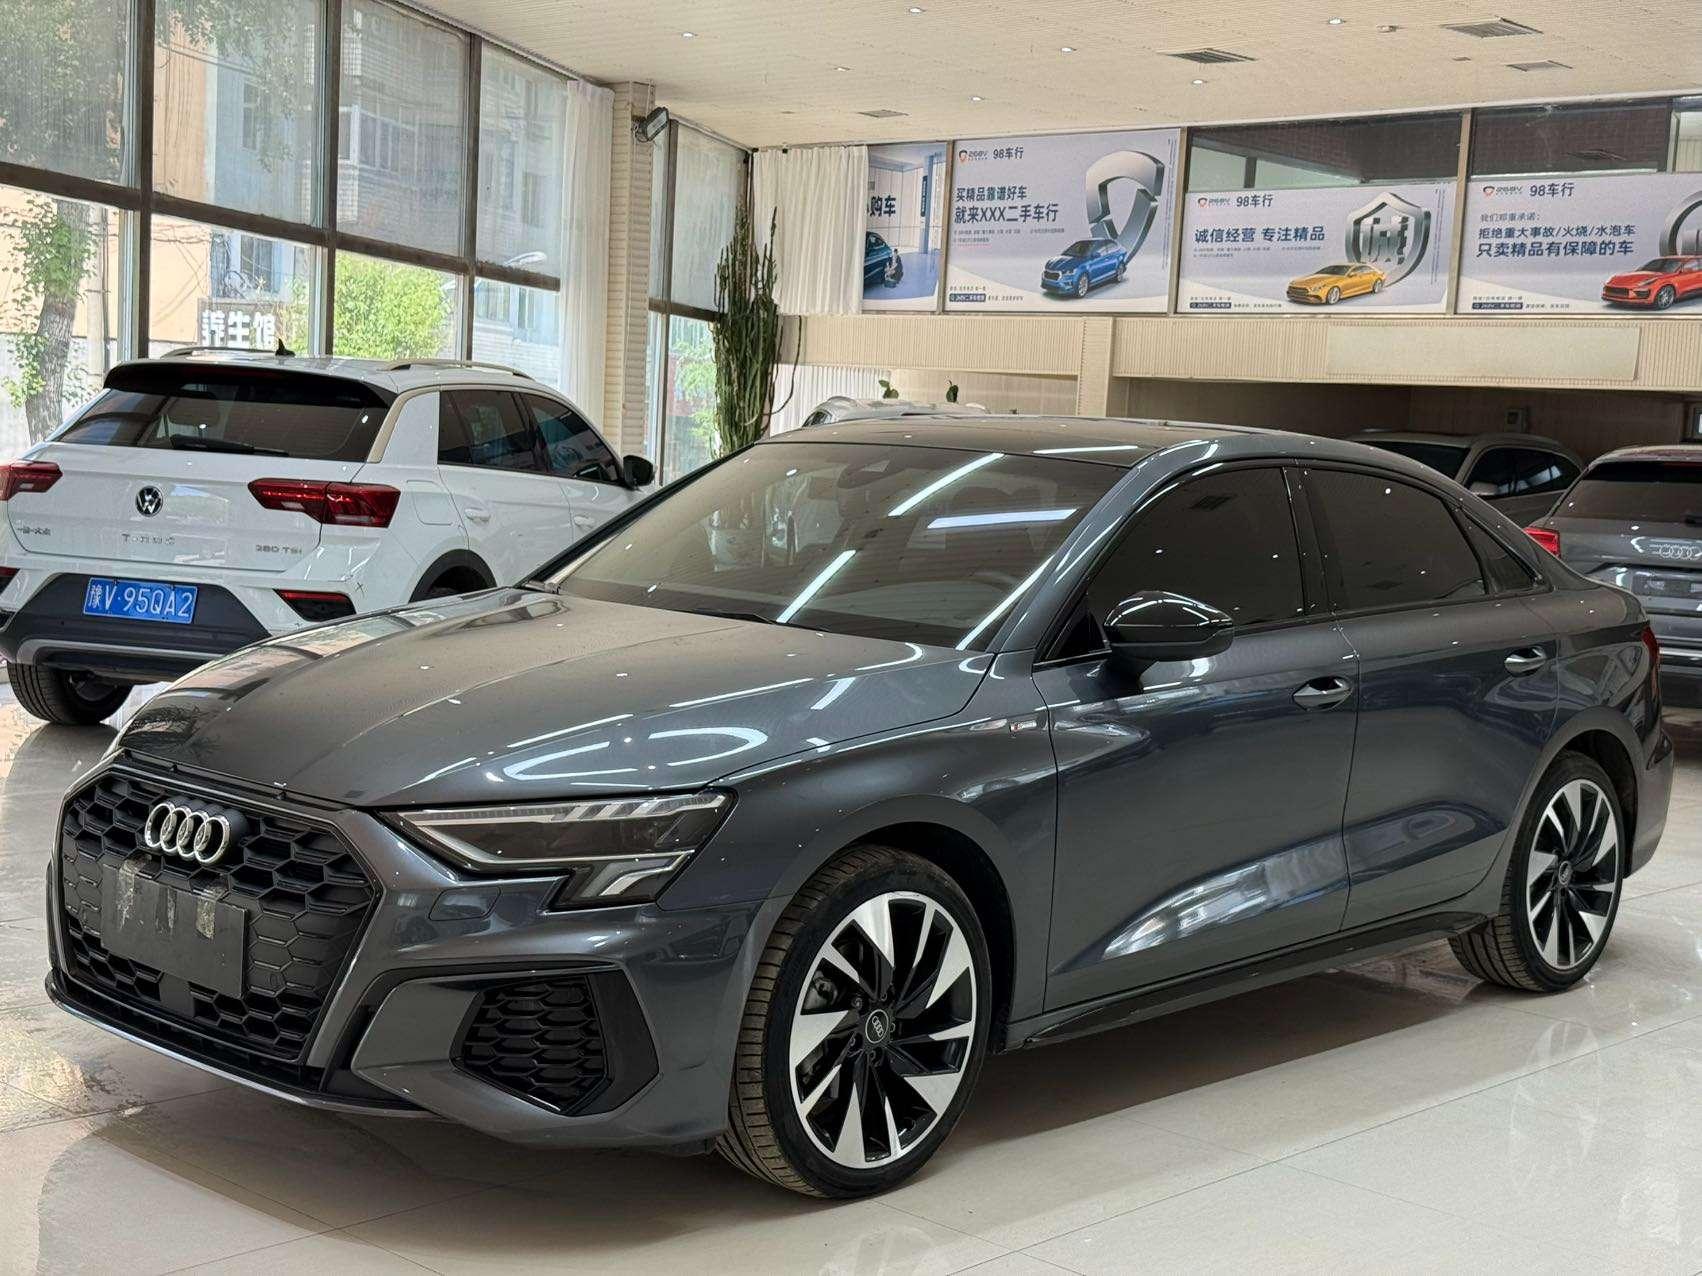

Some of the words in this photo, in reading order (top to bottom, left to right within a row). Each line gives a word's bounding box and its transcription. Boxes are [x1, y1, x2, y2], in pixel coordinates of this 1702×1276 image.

[993, 147, 1024, 159] 98车行
[956, 185, 1027, 201] 买精品靠谱好车
[1530, 182, 1575, 197] 98车行
[867, 195, 896, 217] 购车
[1236, 194, 1273, 207] 98车行
[954, 202, 1059, 223] 就来XXX二手车行
[1194, 227, 1256, 243] 诚信经营
[1261, 225, 1325, 242] 专注精品
[1478, 224, 1636, 240] 拒绝重大事故/火烧/水泡车
[1476, 240, 1634, 258] 只卖精品有保障的车
